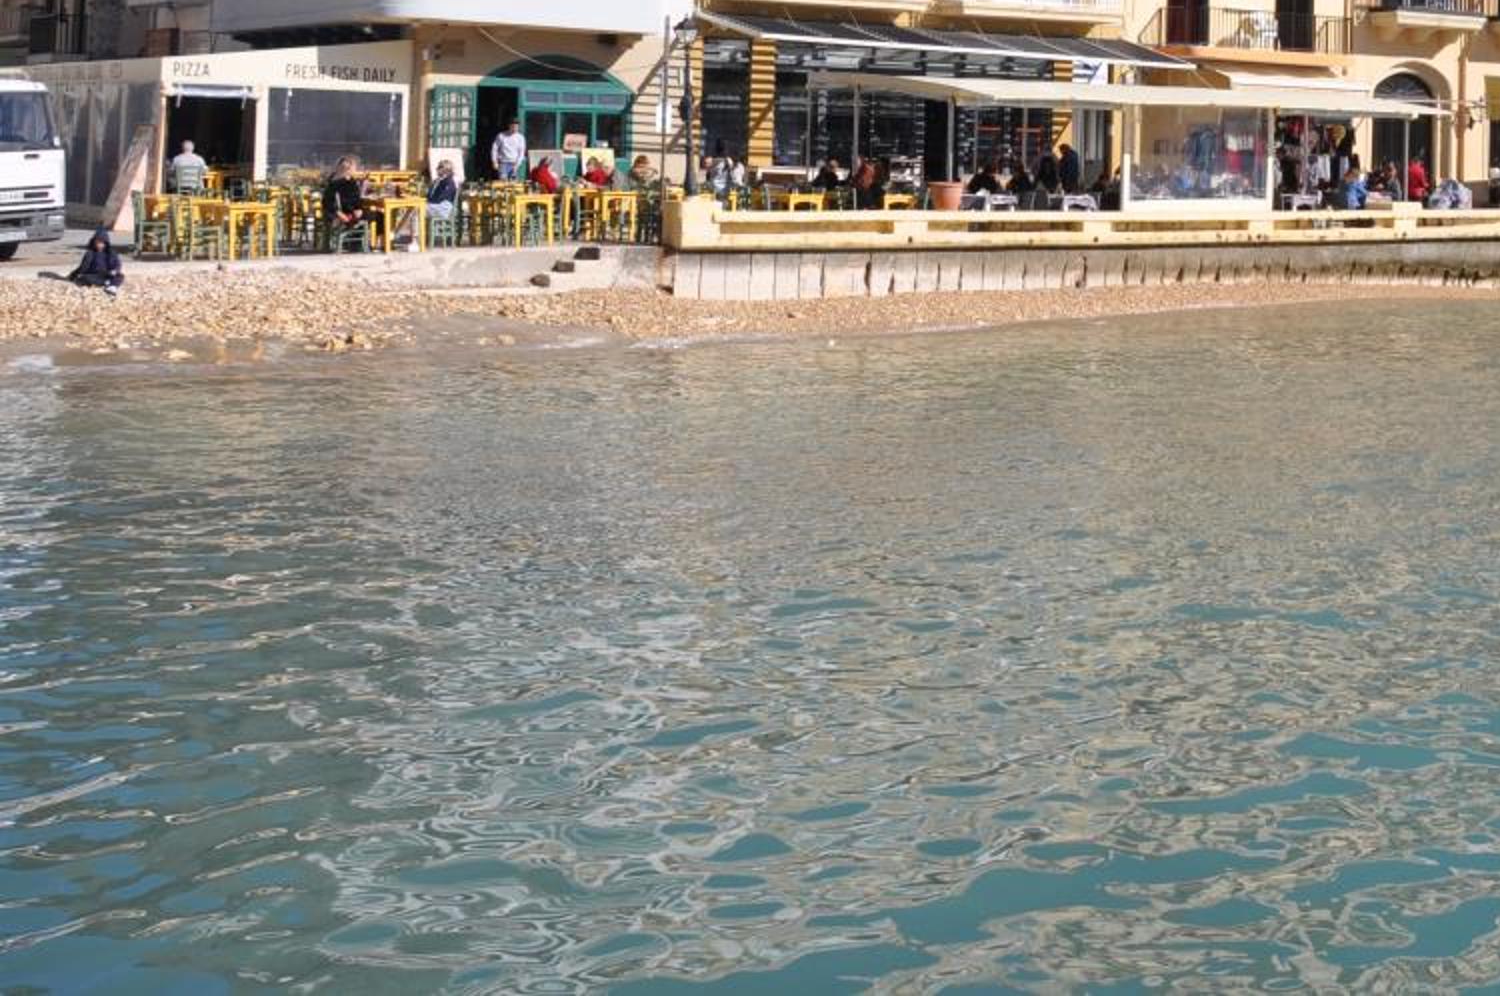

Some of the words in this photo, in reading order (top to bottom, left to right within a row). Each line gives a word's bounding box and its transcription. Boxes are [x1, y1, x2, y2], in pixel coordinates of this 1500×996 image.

[173, 61, 210, 77] PIZZA
[286, 63, 326, 81] FRESH
[331, 65, 359, 81] FISH
[363, 67, 396, 83] DAILY
